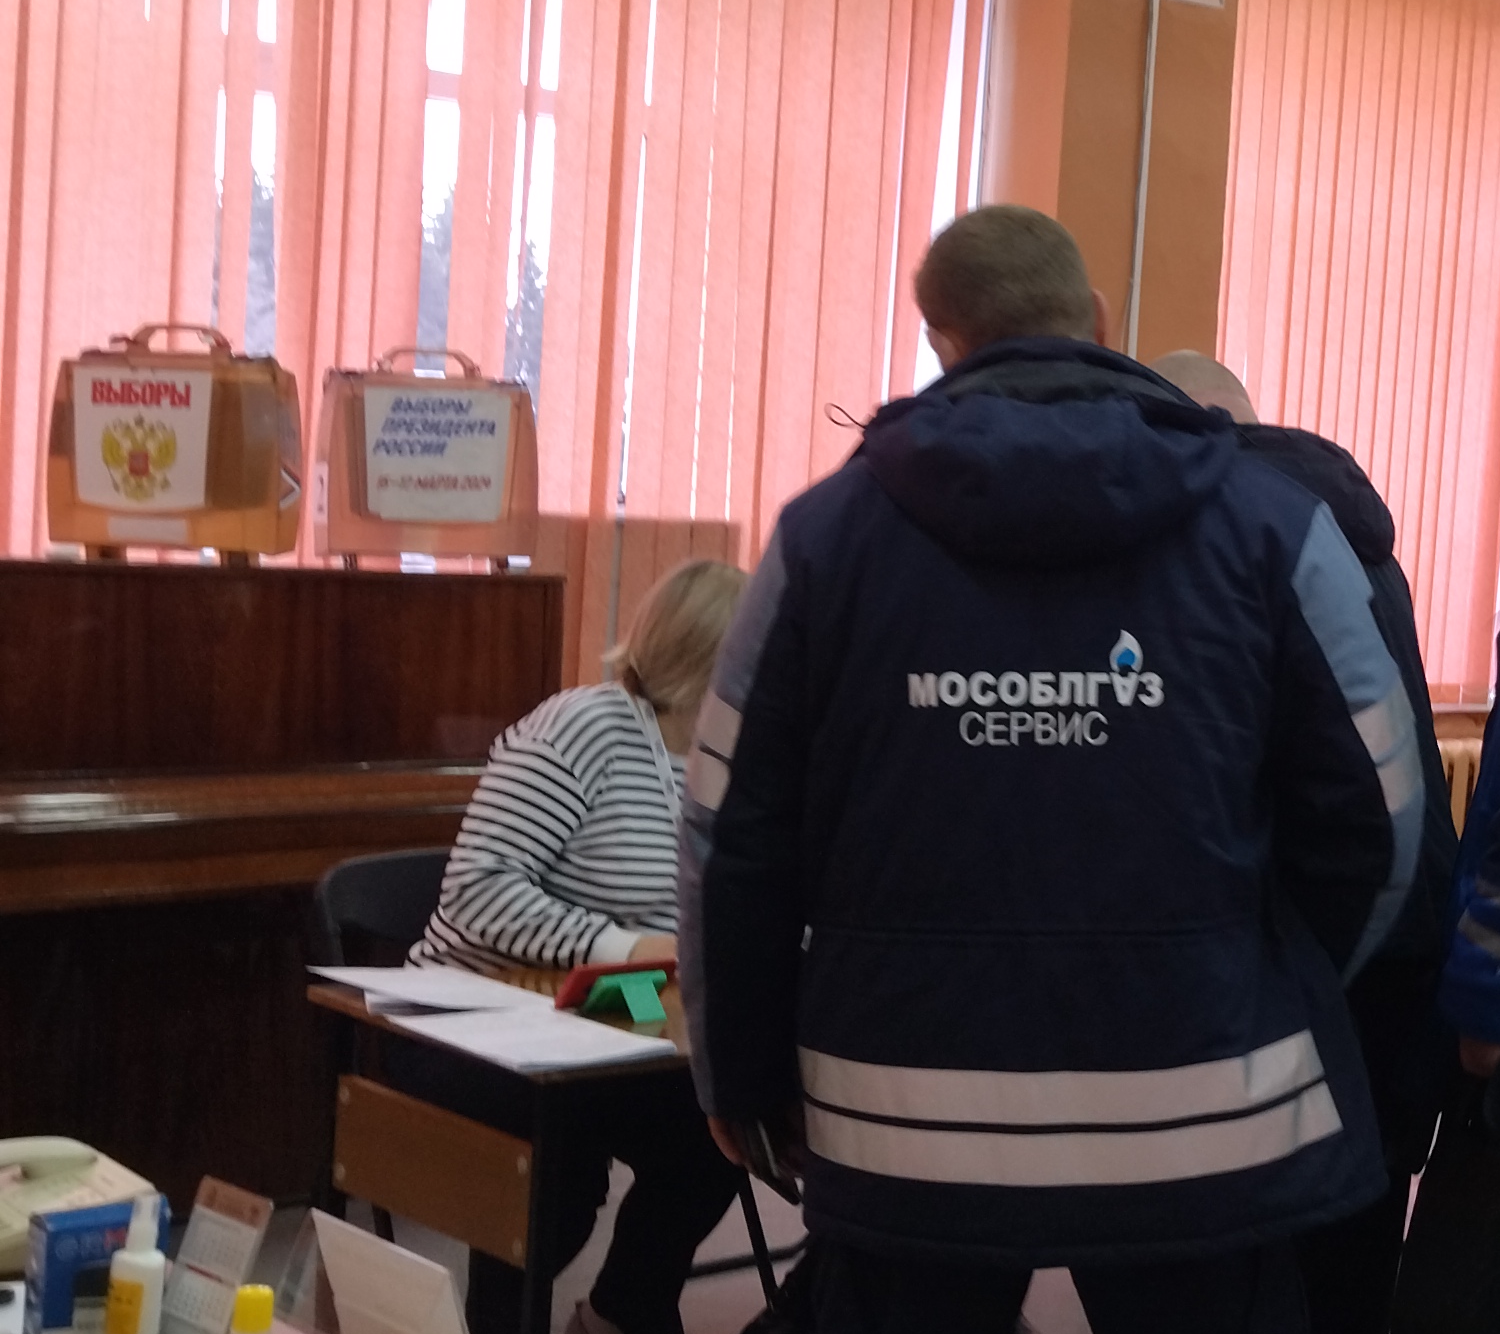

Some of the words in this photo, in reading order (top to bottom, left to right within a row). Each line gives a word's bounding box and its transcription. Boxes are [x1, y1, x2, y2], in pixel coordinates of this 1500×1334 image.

[91, 378, 191, 408] ВЫБОРЫ
[391, 396, 473, 415] ВЫБОРЫ
[381, 417, 496, 437] ПРЕЗИДЕНТА
[372, 437, 448, 457] РОССИИ
[959, 710, 1110, 747] СЕРВИС
